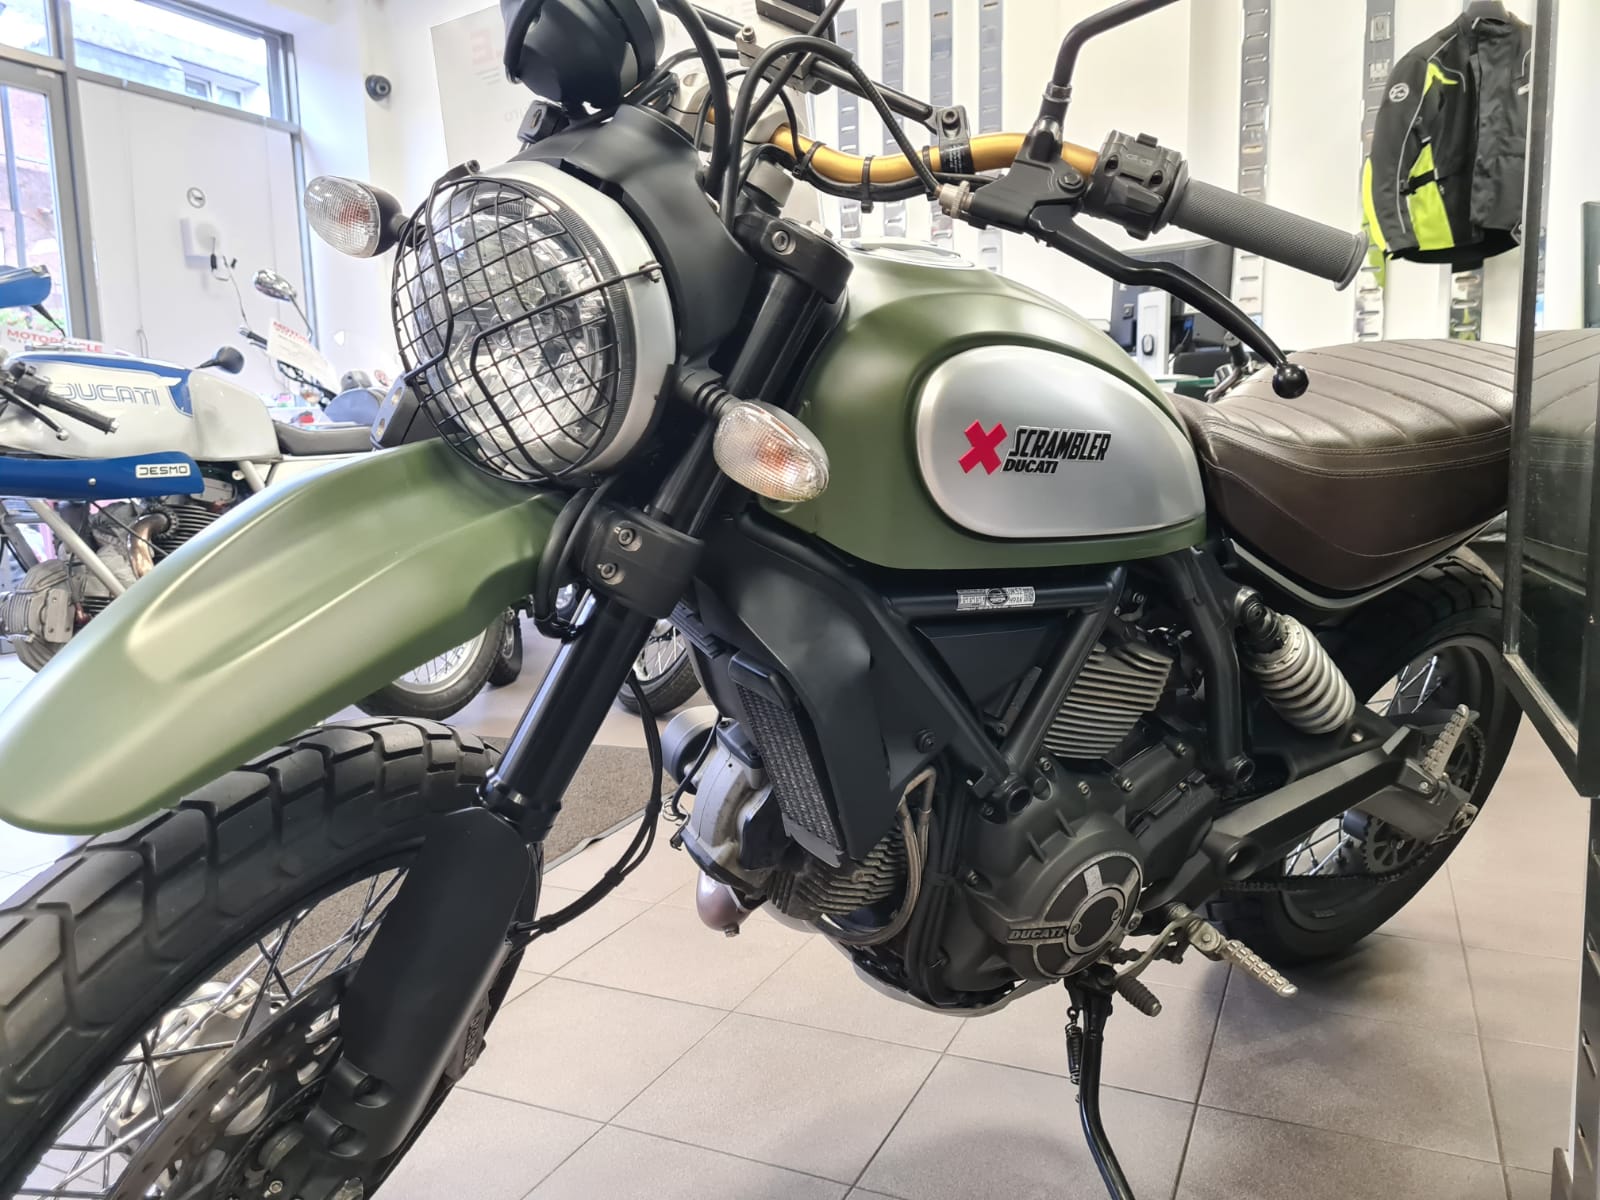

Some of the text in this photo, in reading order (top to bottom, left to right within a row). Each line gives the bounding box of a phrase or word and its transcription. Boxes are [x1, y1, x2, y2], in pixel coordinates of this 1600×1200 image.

[1009, 428, 1111, 461] SCRAMBLER
[139, 465, 188, 476] DESMO
[1002, 458, 1058, 474] DUCATI
[1008, 927, 1065, 940] DUCATI
